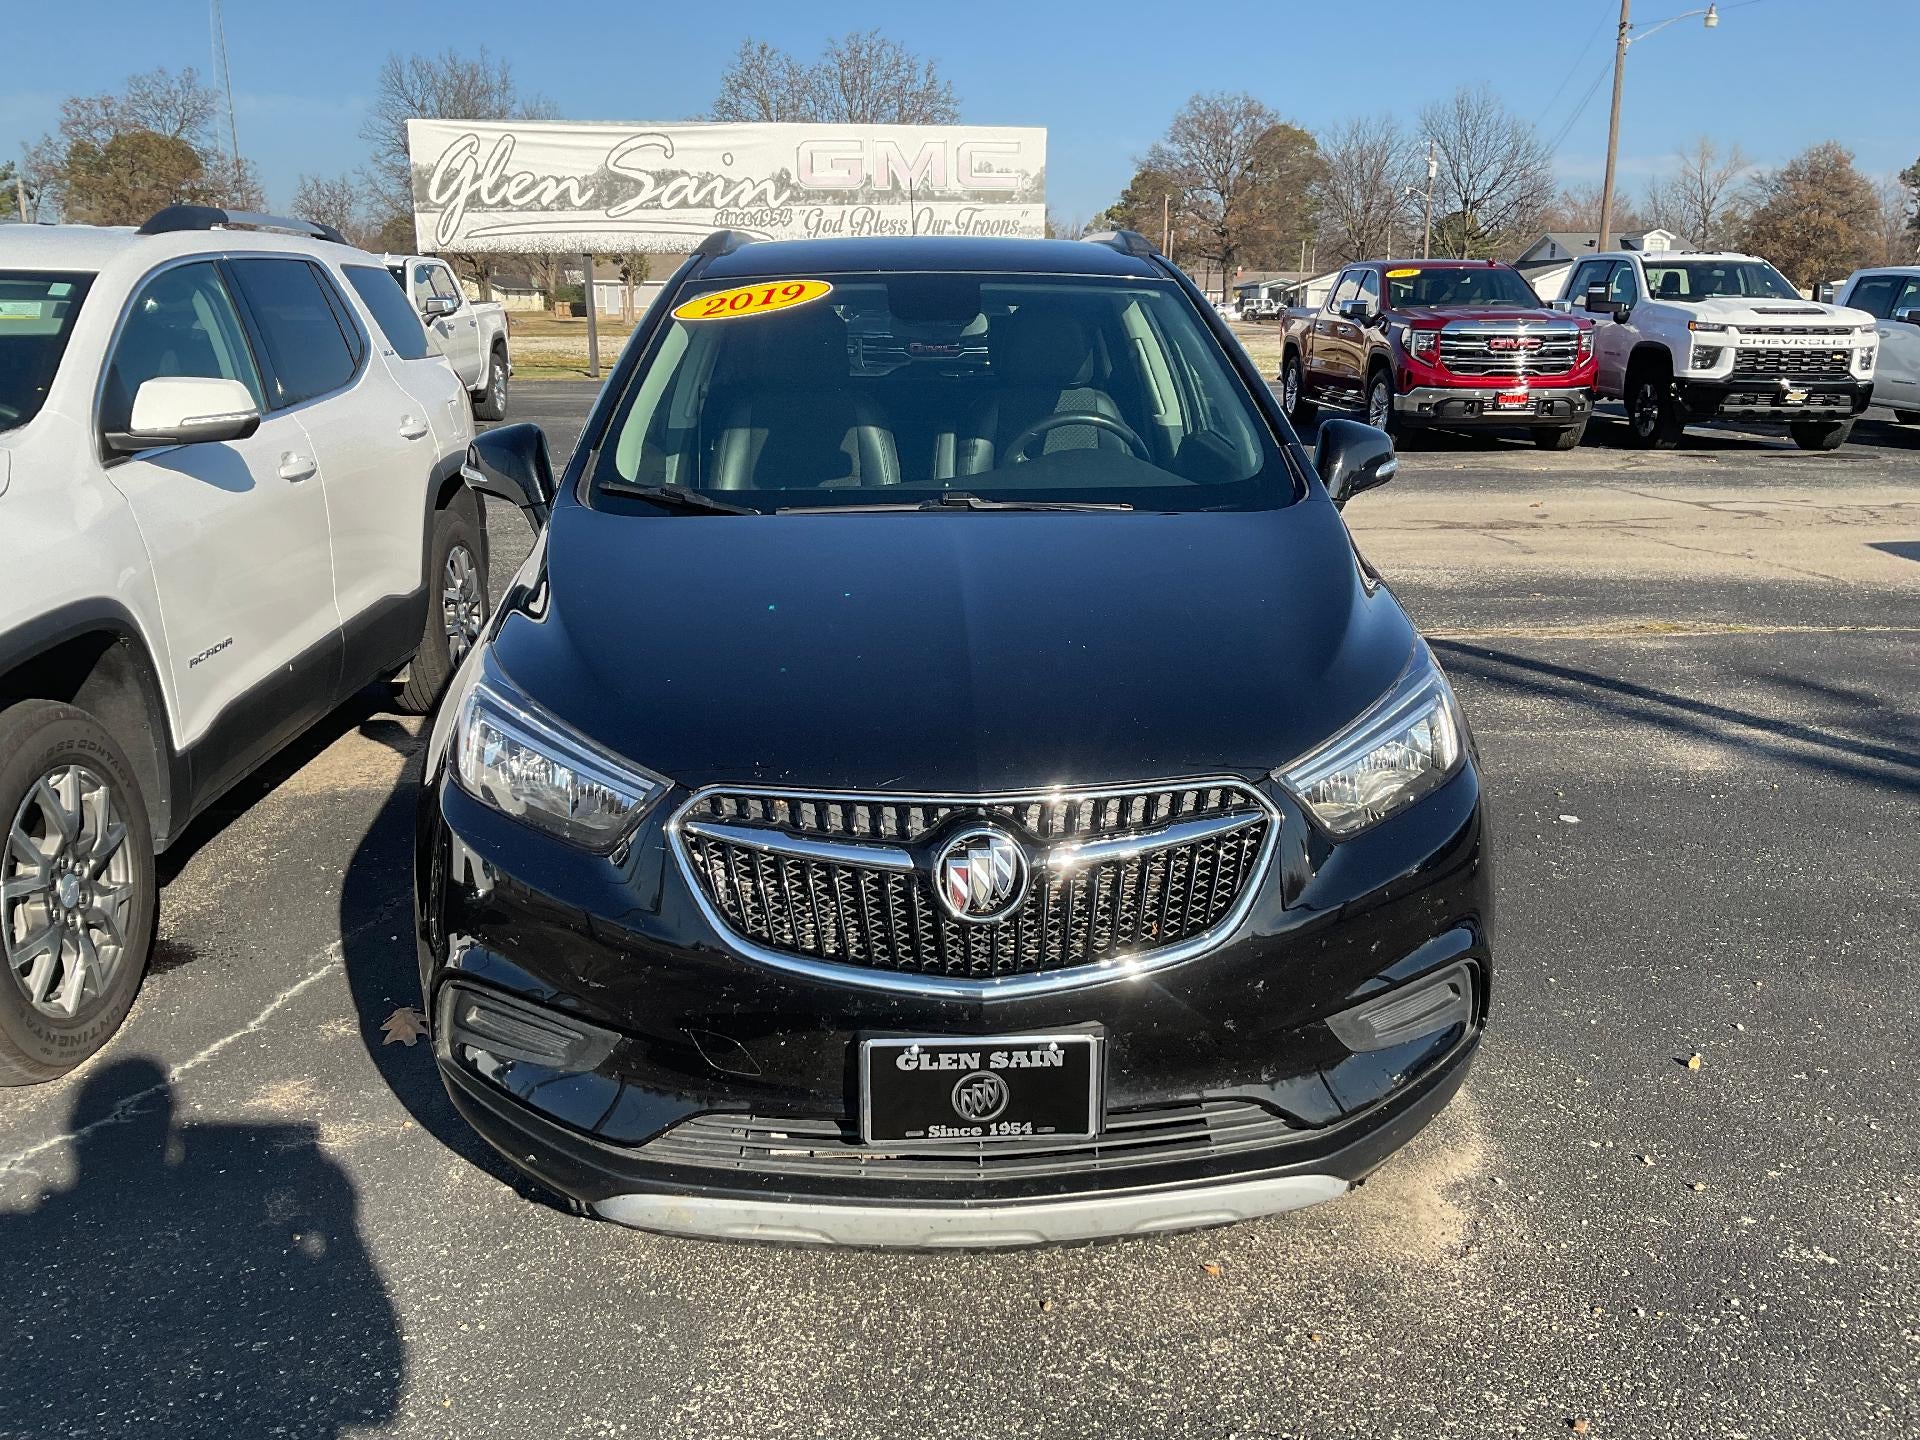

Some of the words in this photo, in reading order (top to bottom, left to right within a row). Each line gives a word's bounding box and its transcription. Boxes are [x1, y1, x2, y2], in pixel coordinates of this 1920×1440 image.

[797, 139, 1021, 190] GMC
[428, 132, 595, 247] Glen
[604, 132, 792, 218] Sain
[713, 209, 753, 227] since
[753, 208, 792, 227] 1954
[849, 206, 908, 236] Bless
[912, 206, 952, 236] Our
[702, 283, 806, 317] 2019
[1490, 338, 1542, 349] GMC
[1739, 338, 1854, 346] CHEVROLET
[189, 637, 232, 668] ACADIA
[895, 1051, 981, 1071] GLEN
[989, 1050, 1065, 1069] SAIN
[928, 1124, 983, 1138] Since
[989, 1122, 1033, 1135] 1954
